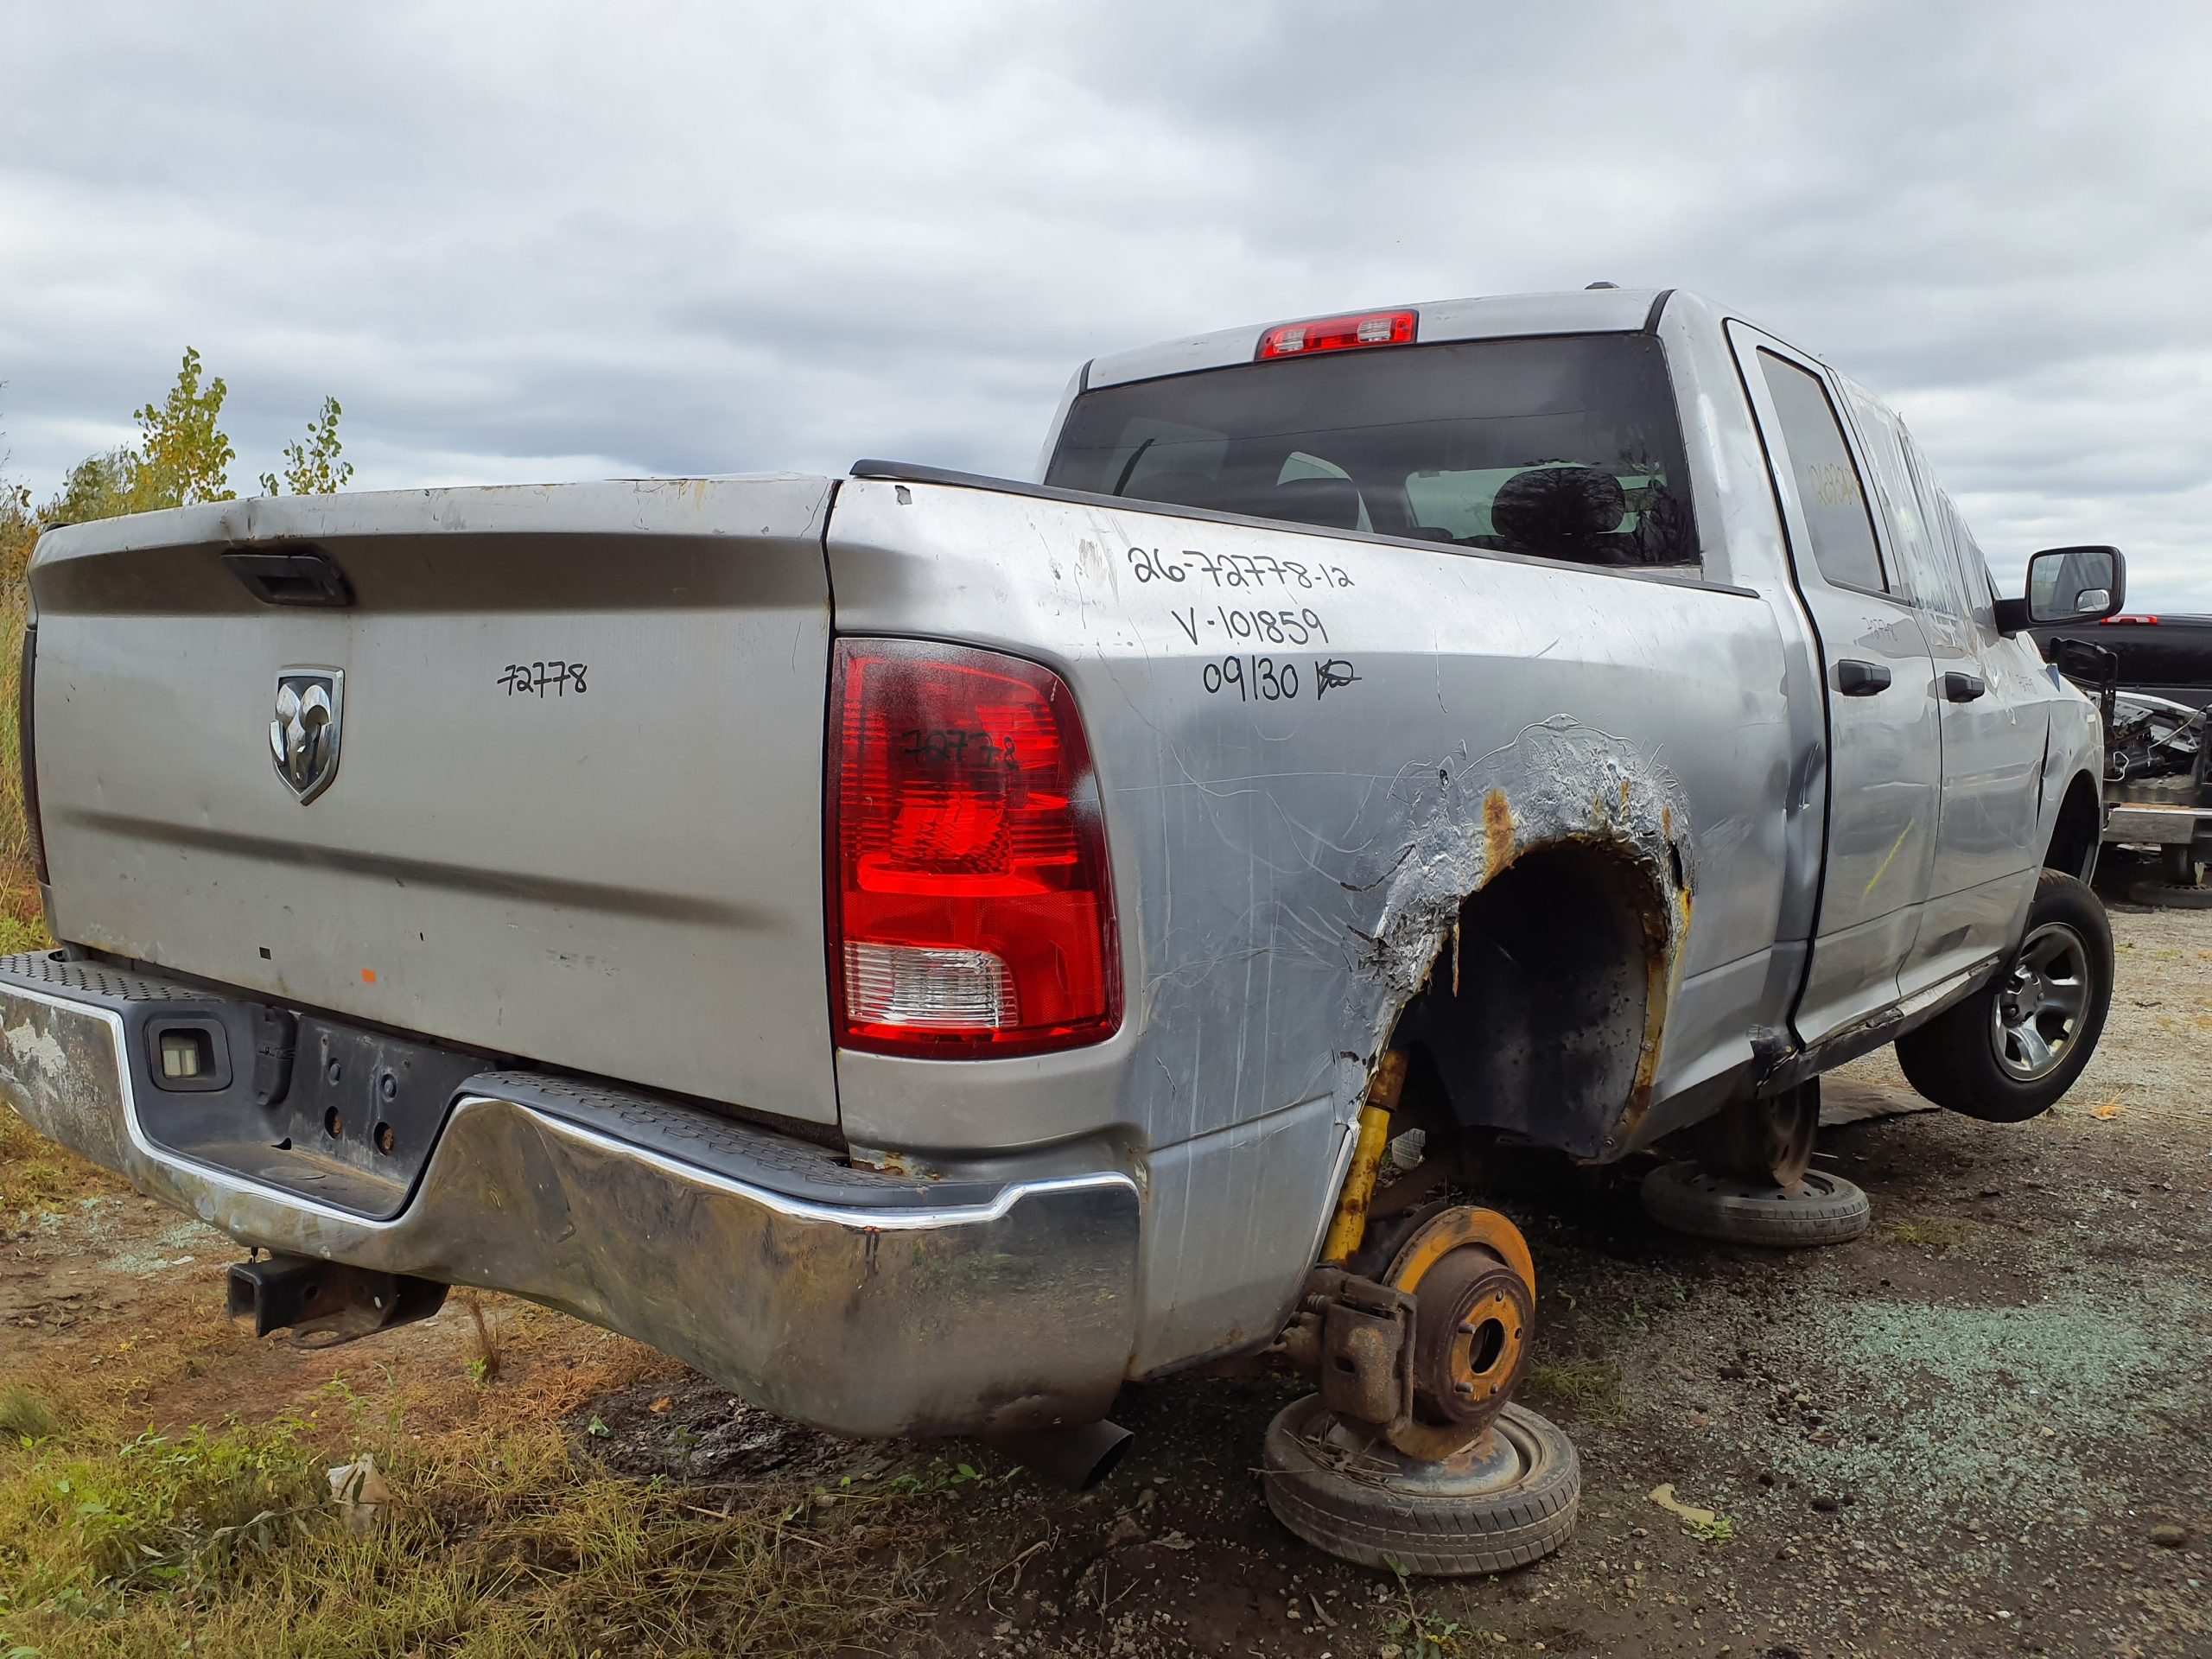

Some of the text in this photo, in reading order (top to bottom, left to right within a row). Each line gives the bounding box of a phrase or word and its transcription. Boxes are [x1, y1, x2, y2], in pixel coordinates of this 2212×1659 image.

[1127, 546, 1356, 589] 26-72778-12
[1171, 605, 1329, 645] V-101859
[497, 660, 588, 699] 72778
